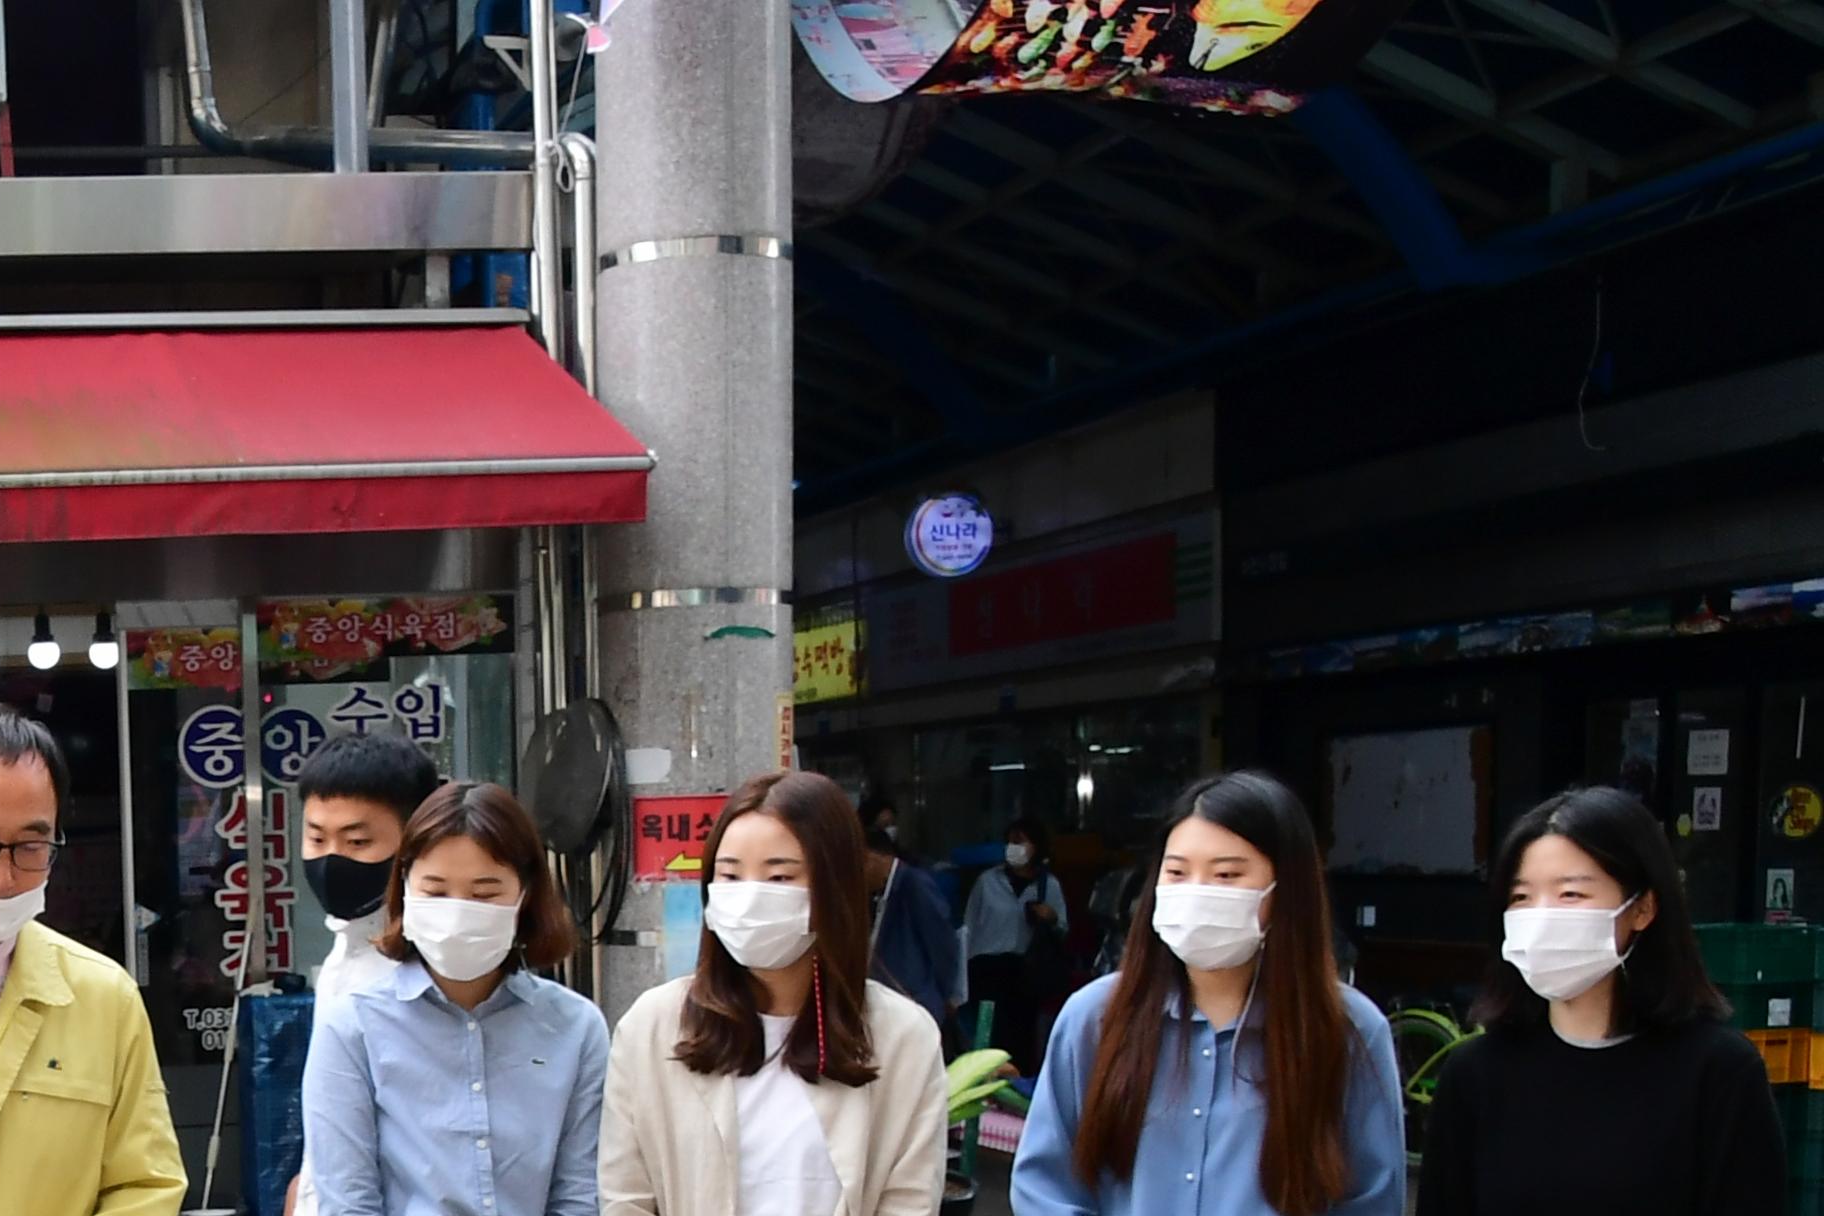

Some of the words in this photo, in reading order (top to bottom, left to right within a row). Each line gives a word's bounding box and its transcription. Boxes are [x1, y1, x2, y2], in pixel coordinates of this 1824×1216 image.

[930, 522, 978, 542] 신나라
[304, 612, 460, 645] 중앙식육점
[178, 643, 239, 673] 중앙
[329, 682, 447, 743] 수입
